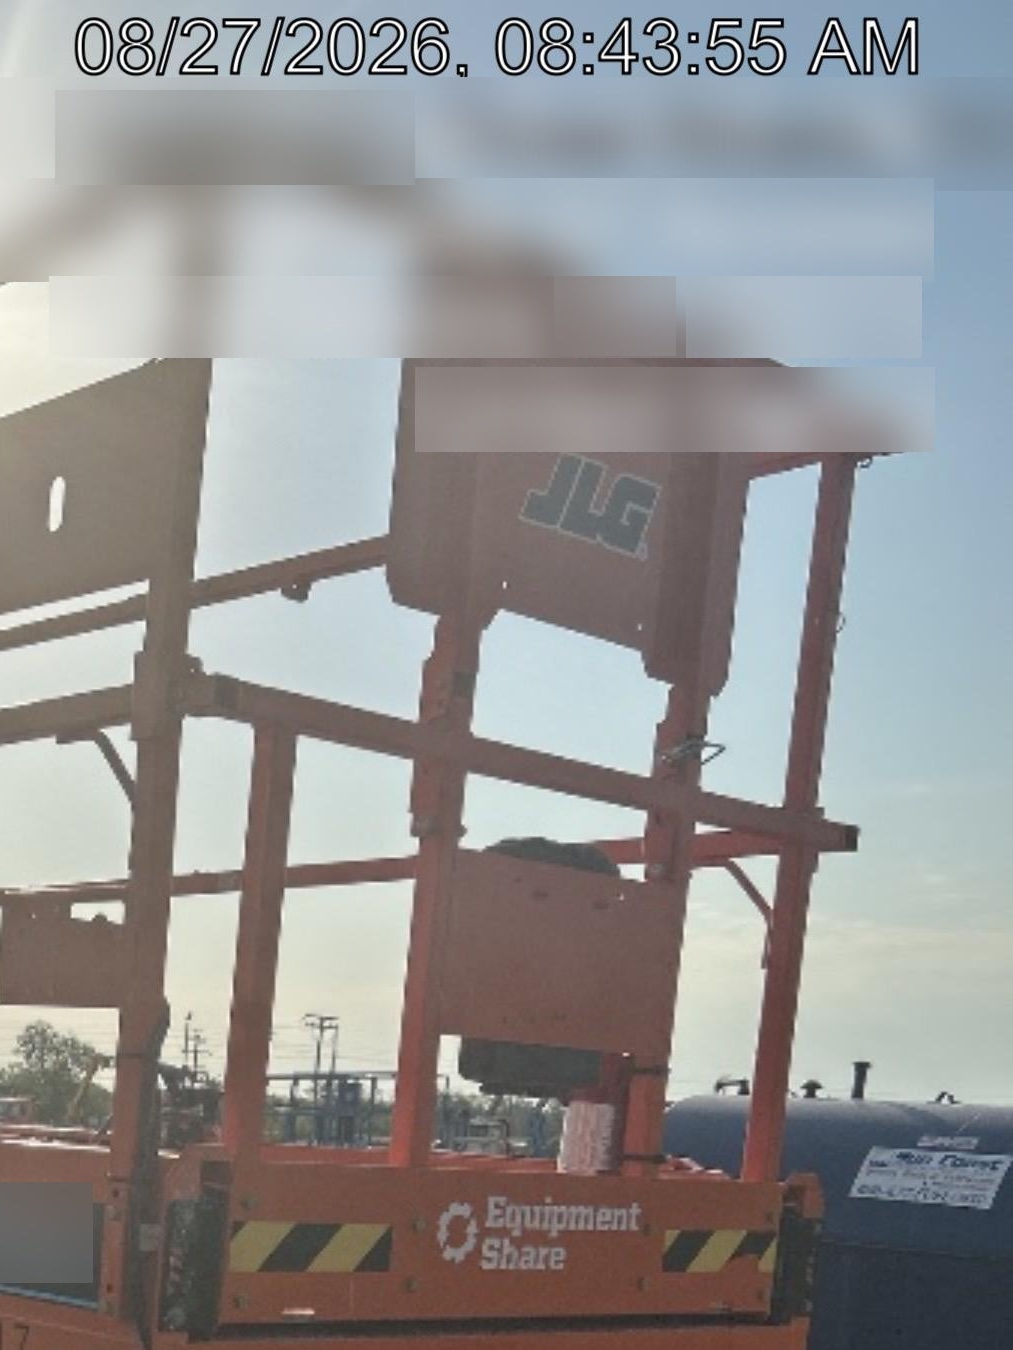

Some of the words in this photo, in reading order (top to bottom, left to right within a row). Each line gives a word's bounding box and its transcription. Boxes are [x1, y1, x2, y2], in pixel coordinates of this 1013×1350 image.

[518, 452, 662, 558] JLG
[485, 1196, 641, 1237] Equipment
[481, 1238, 567, 1270] Share
